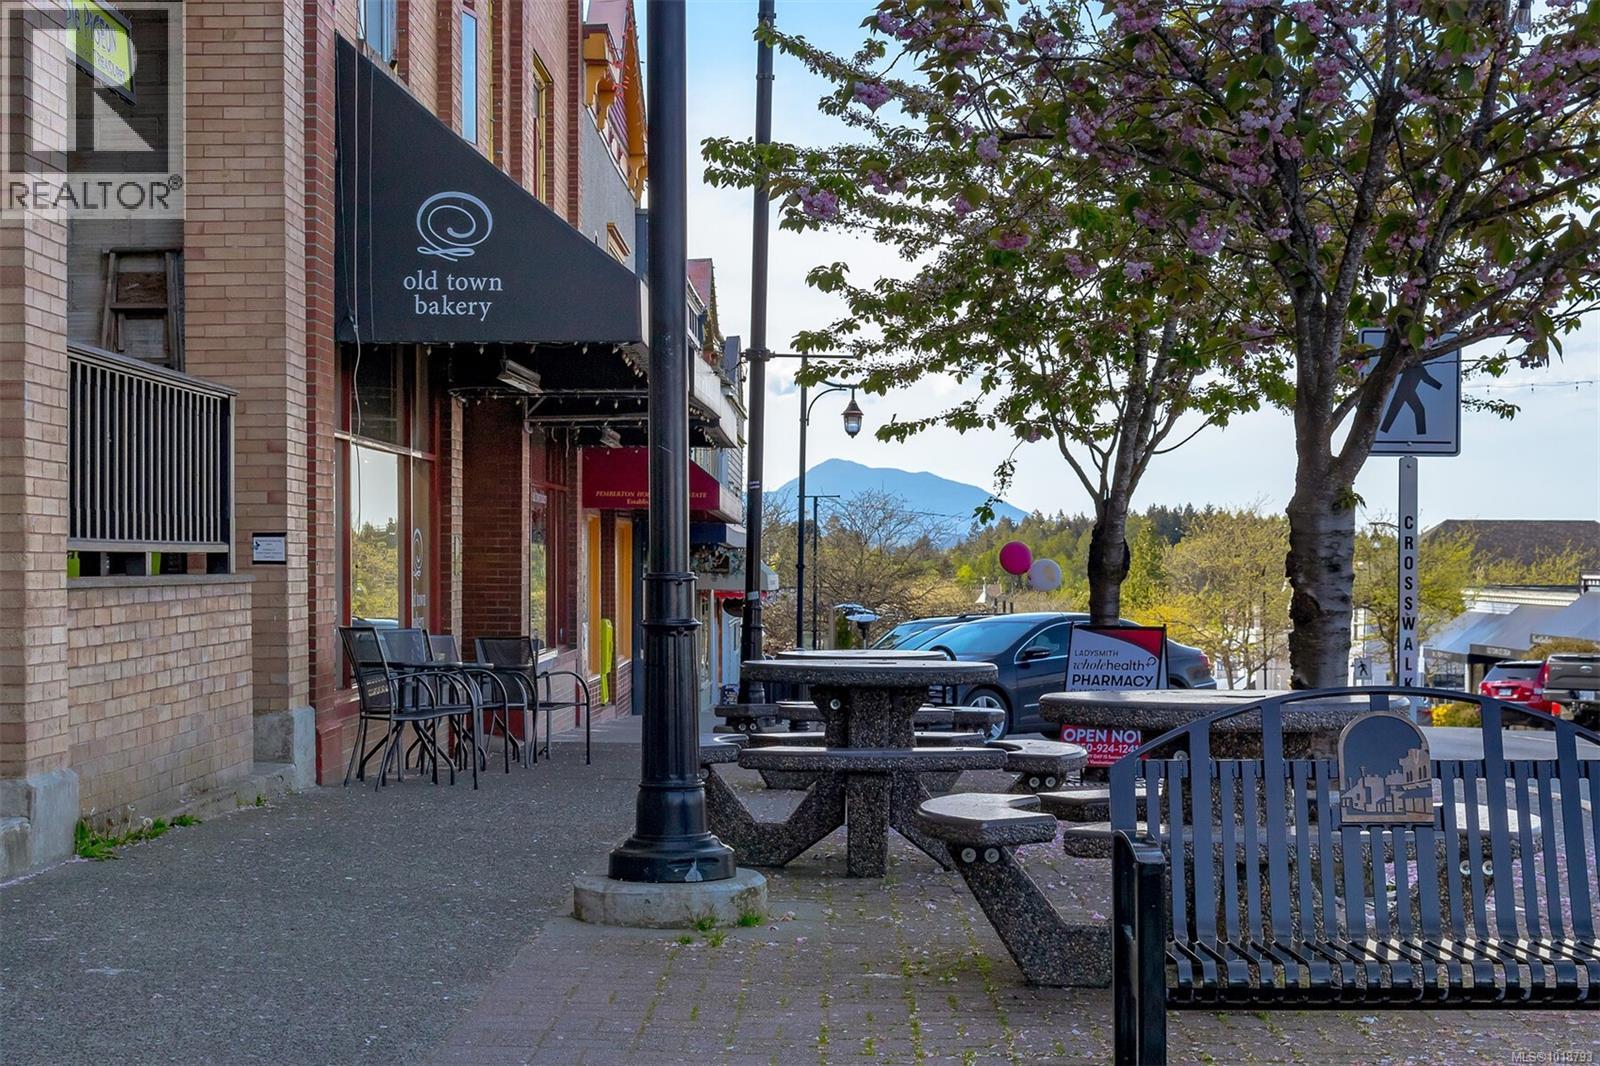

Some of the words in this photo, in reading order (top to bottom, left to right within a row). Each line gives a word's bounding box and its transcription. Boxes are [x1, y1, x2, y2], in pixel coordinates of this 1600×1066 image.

[403, 269, 438, 291] old
[446, 273, 504, 291] town
[414, 294, 493, 322] bakery
[1402, 515, 1416, 687] CROSSWALK
[1074, 649, 1119, 657] LADYSMITH
[1072, 673, 1154, 687] PHARMACY
[1063, 728, 1108, 742] OPEN
[1111, 729, 1142, 743] NO
